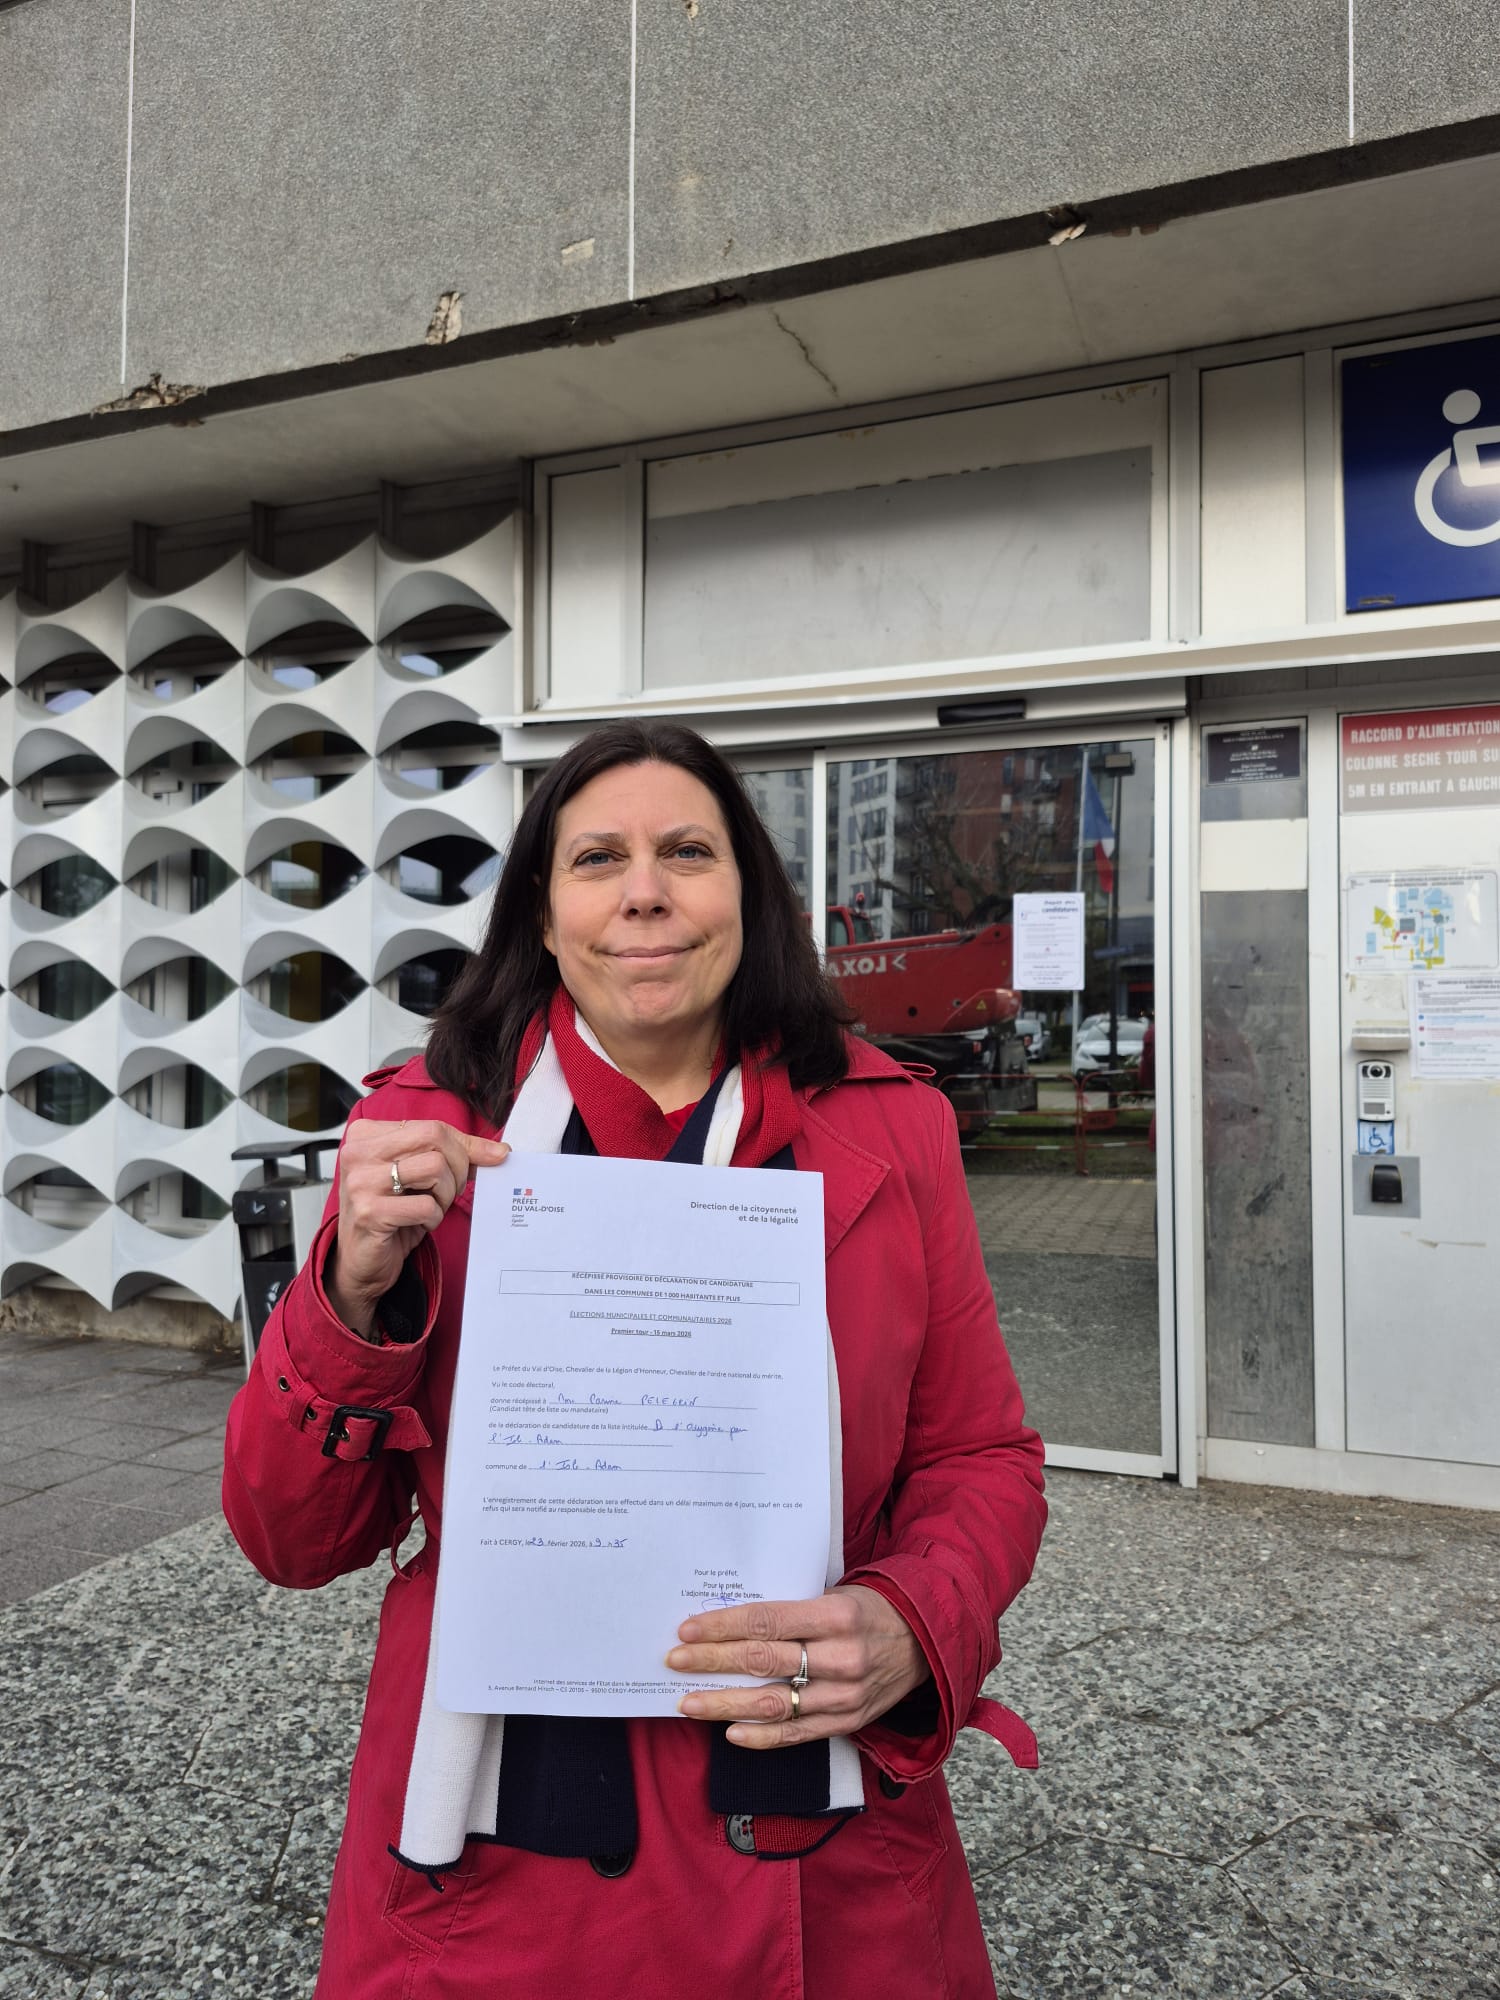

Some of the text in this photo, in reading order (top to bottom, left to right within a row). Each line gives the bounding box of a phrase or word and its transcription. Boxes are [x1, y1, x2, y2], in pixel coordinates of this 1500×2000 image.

[1351, 726, 1403, 744] RACCORD
[1345, 747, 1500, 772] COLONNE SECHE TOUR SU
[1348, 783, 1365, 798] 5M
[1370, 782, 1385, 797] EN
[1389, 780, 1441, 796] ENTRANT
[1446, 778, 1454, 793] A
[512, 1197, 539, 1205] PRÉFET
[524, 1205, 565, 1213] VAL-D'OISE
[690, 1202, 797, 1215] Direction de la citoyenneté
[761, 1215, 768, 1223] la
[770, 1216, 799, 1225] légalité
[605, 1274, 643, 1282] PROVISOIRE
[654, 1275, 698, 1285] DÉCLARATION
[709, 1280, 754, 1288] CANDIDATURE
[616, 1289, 653, 1297] COMMUNES
[680, 1293, 716, 1301] HABITANTS
[569, 1310, 605, 1319] ÉLECTIONS
[606, 1312, 648, 1320] MUNICIPALES
[658, 1314, 717, 1324] COMMUNAUTAIRES
[610, 1327, 635, 1335] Premier
[677, 1330, 692, 1338] 2026
[612, 1367, 632, 1375] Légion
[633, 1368, 668, 1376] d'Honneur,
[727, 1371, 752, 1379] national
[761, 1373, 784, 1381] mérite,
[489, 1405, 521, 1414] (Candidat
[570, 1407, 609, 1415] mandataire)
[483, 1497, 537, 1505] L'enregistrement
[538, 1497, 547, 1505] de
[567, 1498, 604, 1506] déclaration
[619, 1498, 647, 1506] effectué
[675, 1499, 692, 1507] délai
[724, 1500, 733, 1508] de
[739, 1501, 757, 1509] jours,
[499, 1505, 510, 1513] qui
[526, 1505, 547, 1513] notifié
[557, 1506, 596, 1515] responsable
[597, 1506, 606, 1514] de
[499, 1539, 524, 1547] CERGY,
[569, 1540, 588, 1548] 2026,
[717, 1569, 739, 1577] préfet,
[703, 1581, 718, 1589] Pour
[725, 1582, 745, 1590] préfet,
[681, 1589, 709, 1598] L'adjointe
